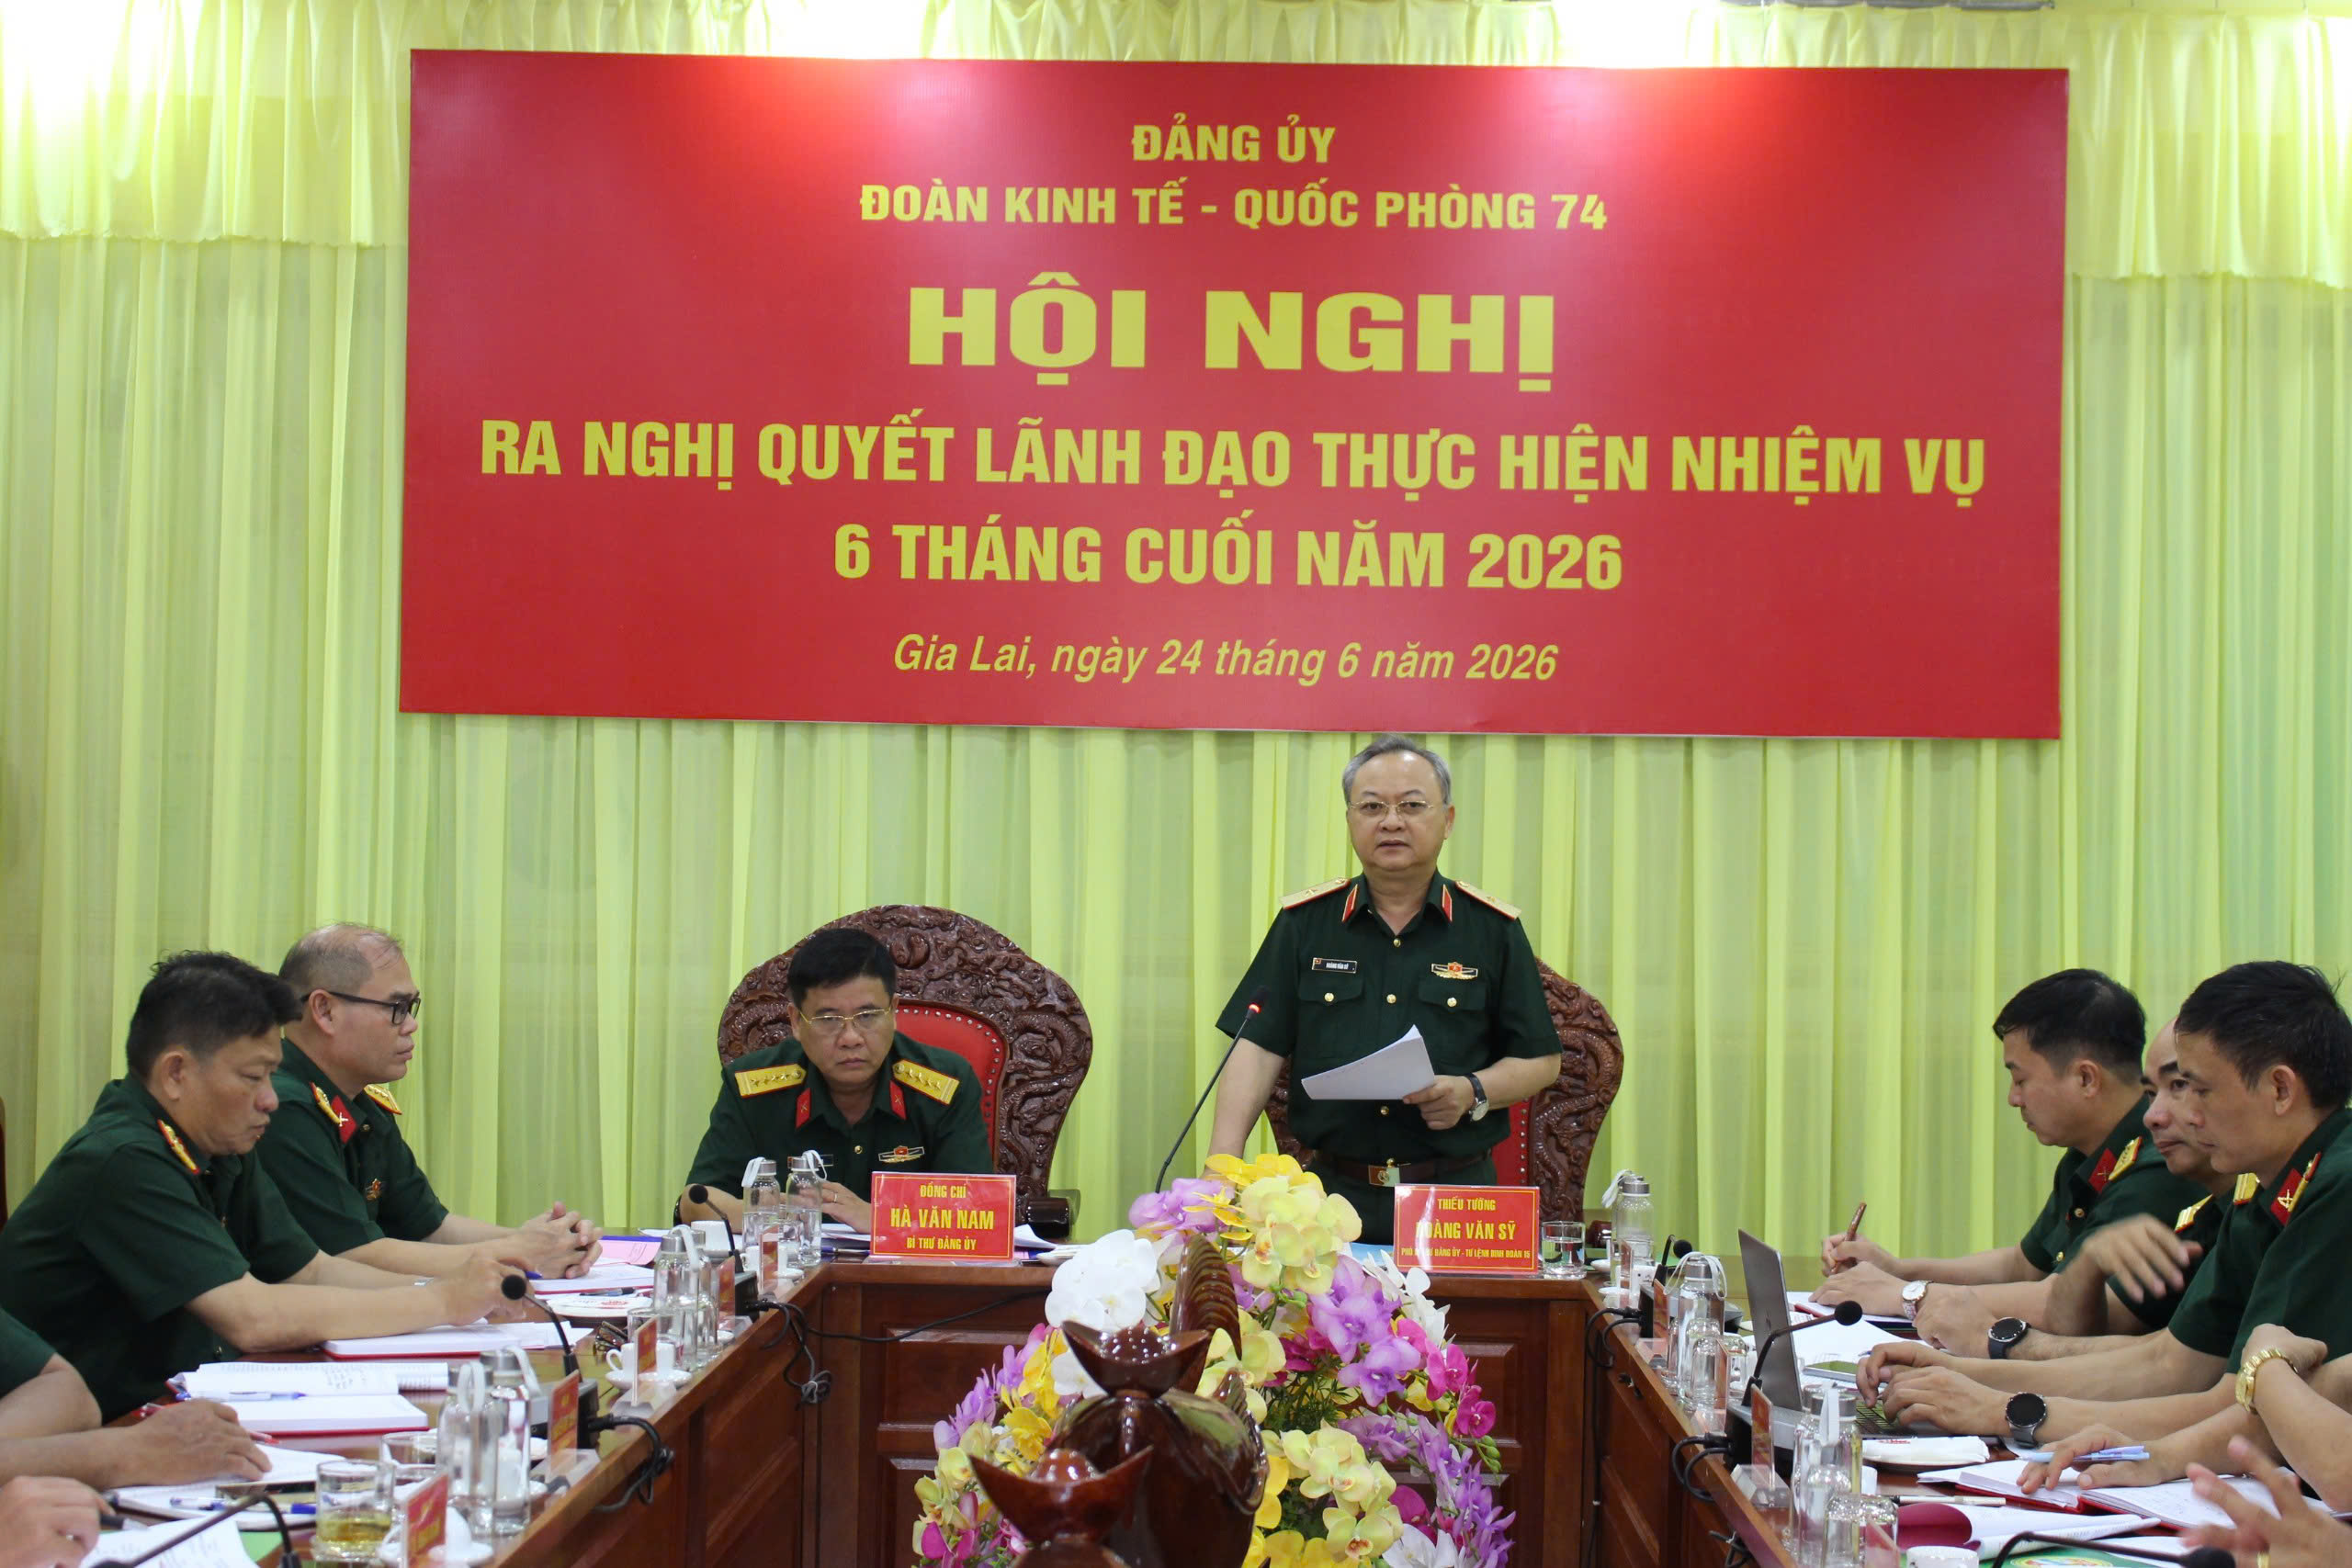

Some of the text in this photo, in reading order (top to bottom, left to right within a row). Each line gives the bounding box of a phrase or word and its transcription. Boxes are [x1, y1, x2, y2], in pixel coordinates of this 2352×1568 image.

[1131, 112, 1336, 163] ĐẢNG ỦY
[860, 176, 1608, 230] ĐOÀN KINH TẾ - QUỐC PHÒNG 74
[909, 271, 1555, 392] HỘI NGHỊ
[481, 408, 1984, 508] RA NGHỊ QUYẾT LÃNH ĐẠO THỰC HIỆN NHIỆM VỤ
[834, 509, 1623, 591] 6 THÁNG CUỐI NĂM 2026
[894, 633, 1559, 687] Gia Lai, ngày 24 tháng 6 năm 2026
[950, 1183, 967, 1199] CHÍ
[1437, 1196, 1464, 1211] THIẾU
[890, 1204, 994, 1230] HÀ VĂN NAM
[907, 1235, 977, 1250] BÍ THƯ ĐẢNG ỦY
[1465, 1220, 1494, 1240] VĂN
[1498, 1220, 1516, 1241] SỸ
